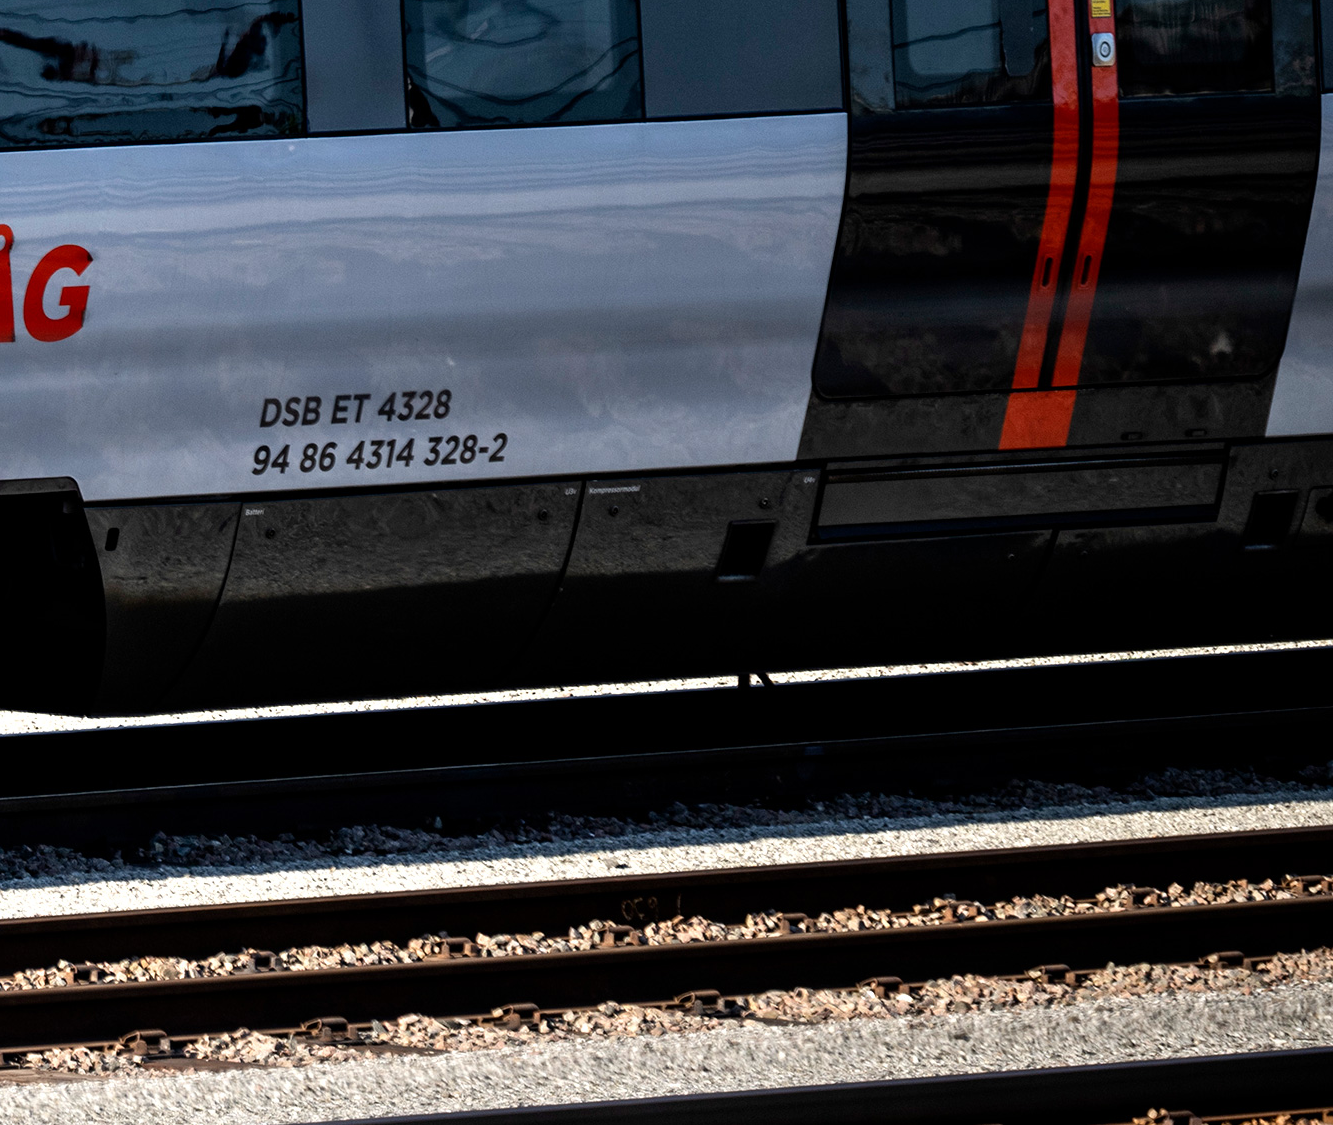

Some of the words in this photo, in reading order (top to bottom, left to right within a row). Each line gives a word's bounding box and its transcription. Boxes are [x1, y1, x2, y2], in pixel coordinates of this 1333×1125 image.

[260, 396, 321, 427] DSB
[331, 394, 371, 424] ET
[378, 389, 451, 421] 4328
[252, 445, 290, 475] 94
[300, 442, 337, 472] 86
[346, 438, 414, 469] 4314
[424, 433, 507, 466] 328-2
